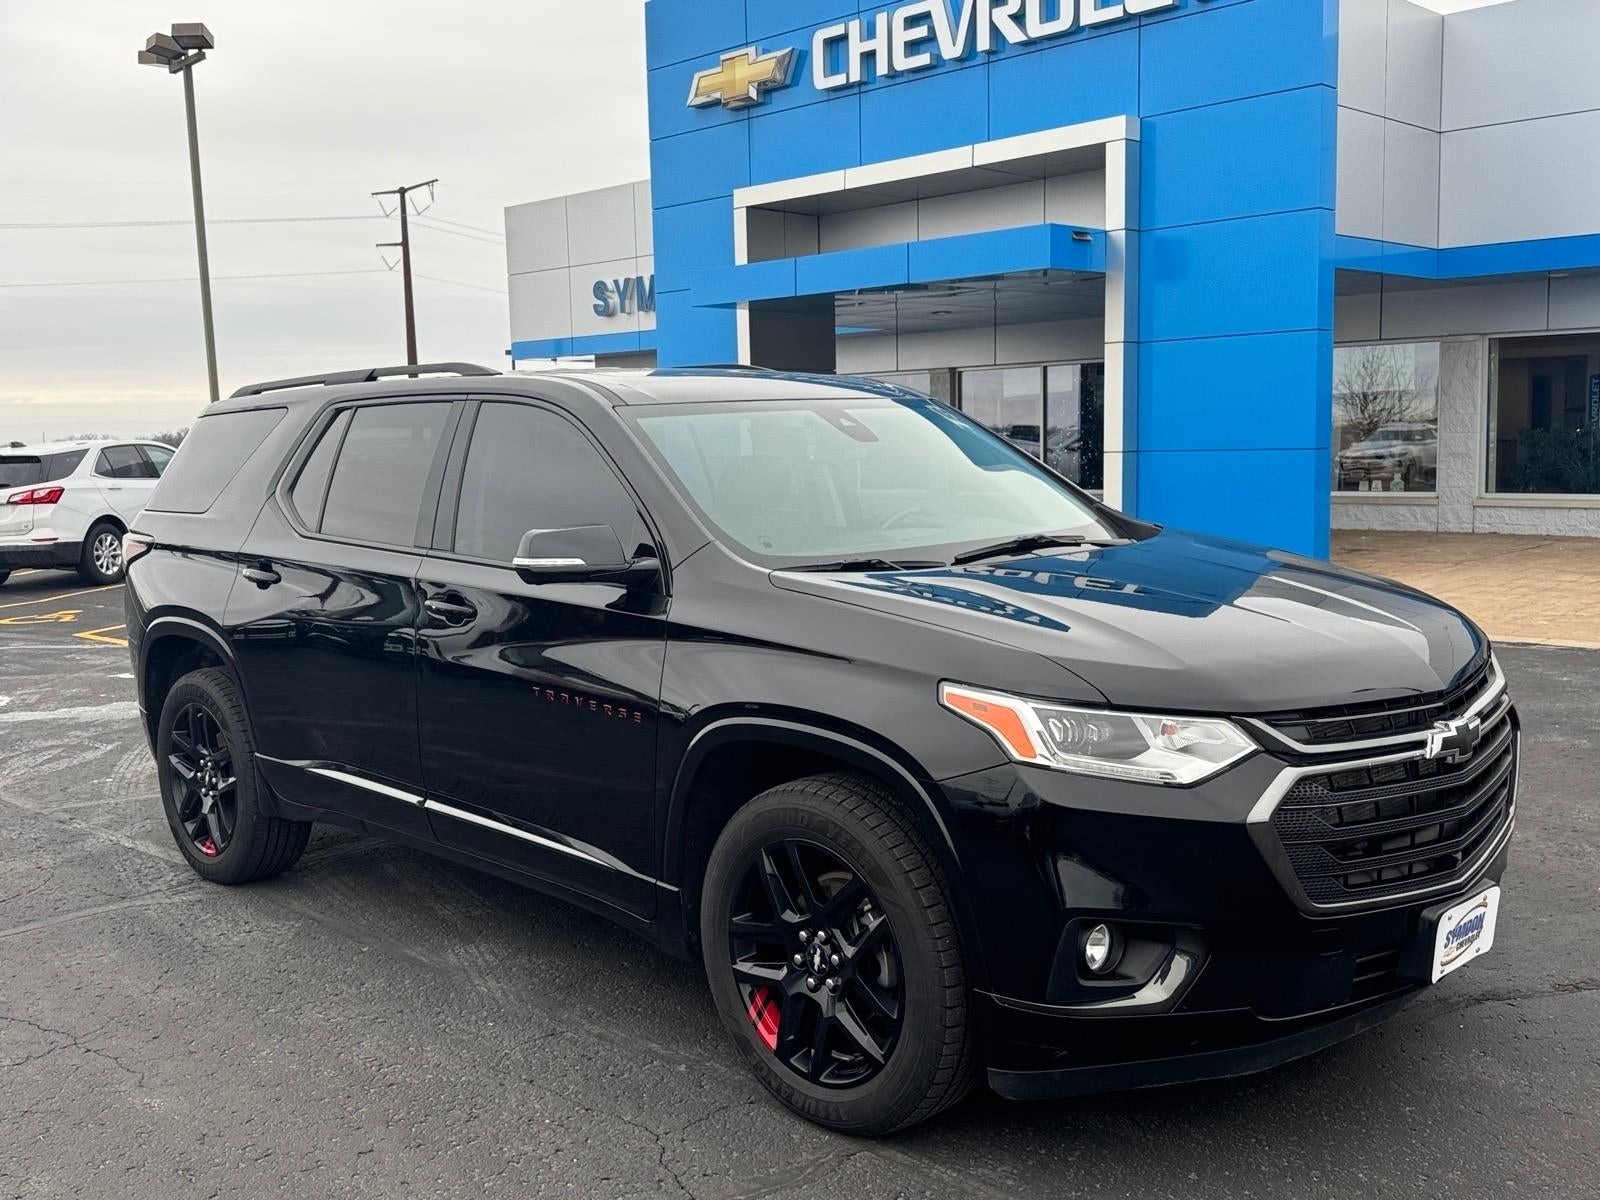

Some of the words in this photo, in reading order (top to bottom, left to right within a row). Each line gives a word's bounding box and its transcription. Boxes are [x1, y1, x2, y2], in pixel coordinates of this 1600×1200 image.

[812, 0, 1211, 91] CHEVRO
[531, 686, 642, 723] TRAVERSE
[1443, 911, 1486, 949] SYMDON
